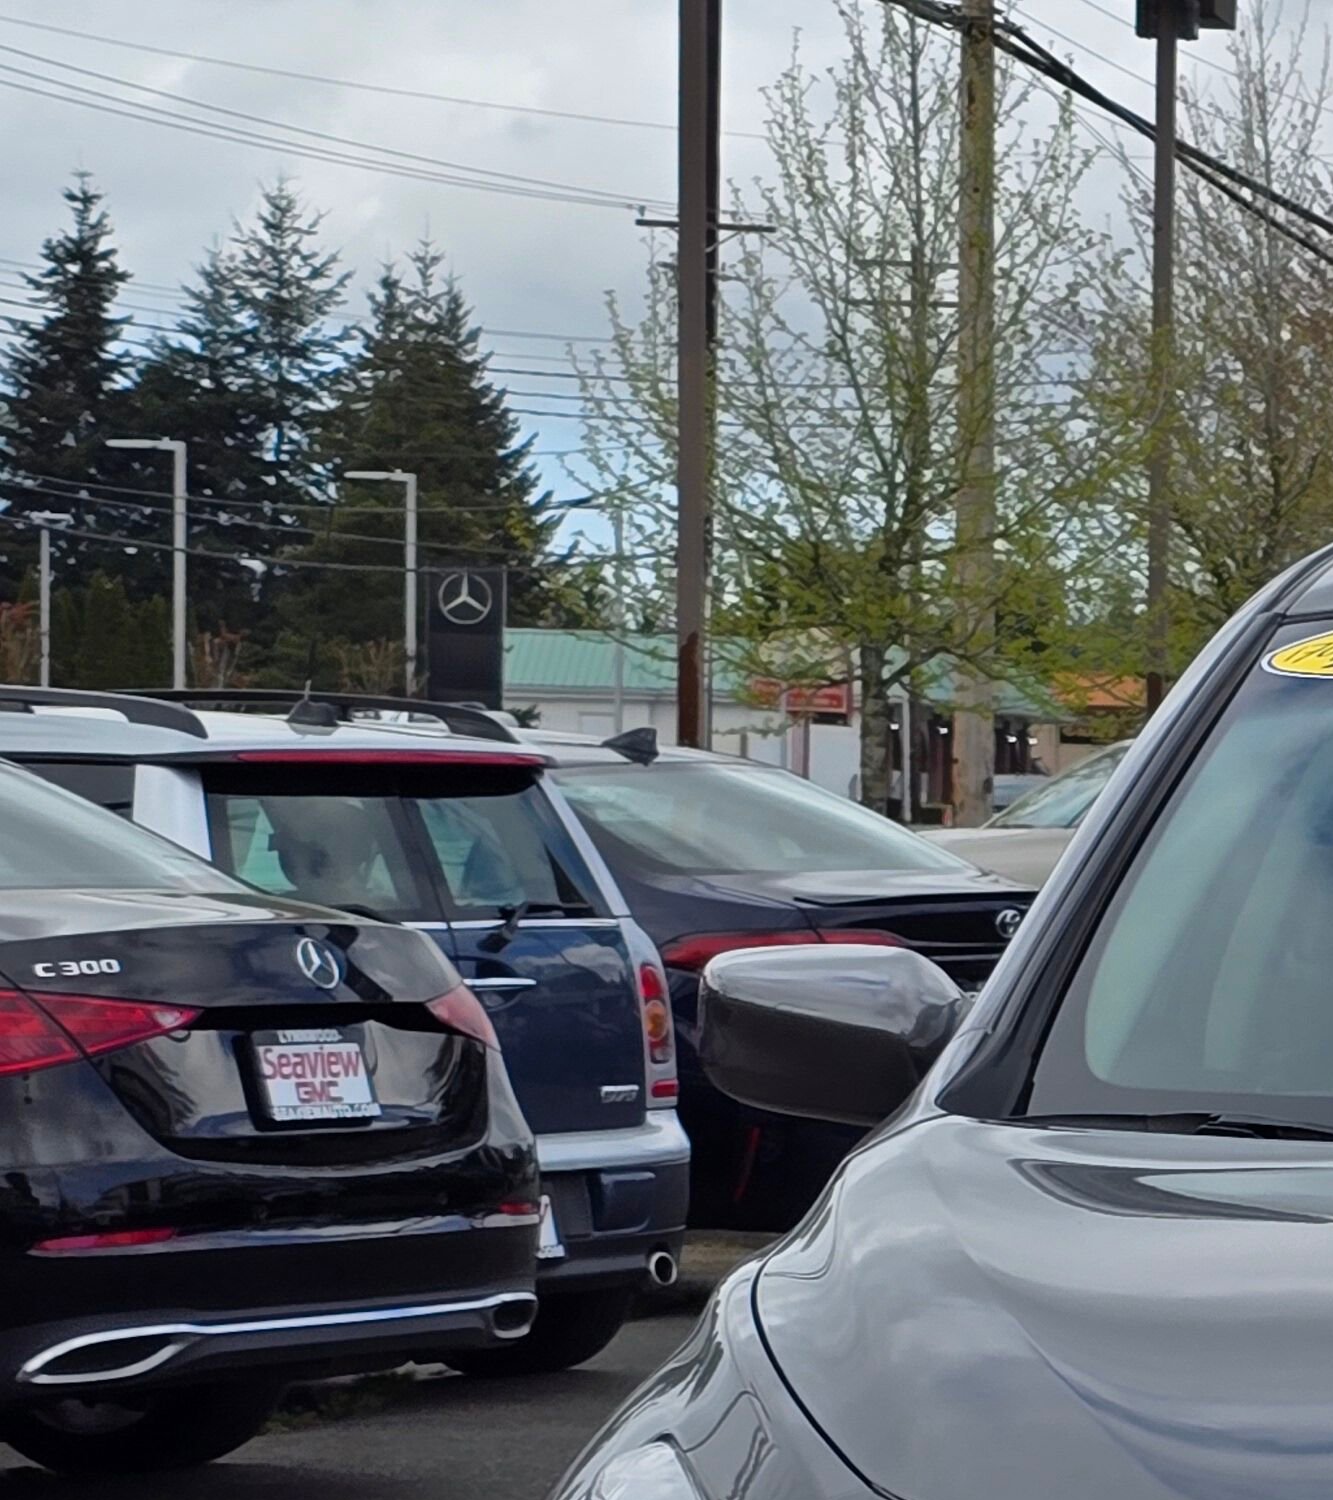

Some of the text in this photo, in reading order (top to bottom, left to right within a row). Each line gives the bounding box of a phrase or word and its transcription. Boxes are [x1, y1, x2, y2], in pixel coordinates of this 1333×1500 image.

[33, 959, 121, 978] C 300
[261, 1047, 361, 1080] Seaview
[295, 1081, 344, 1104] GMC
